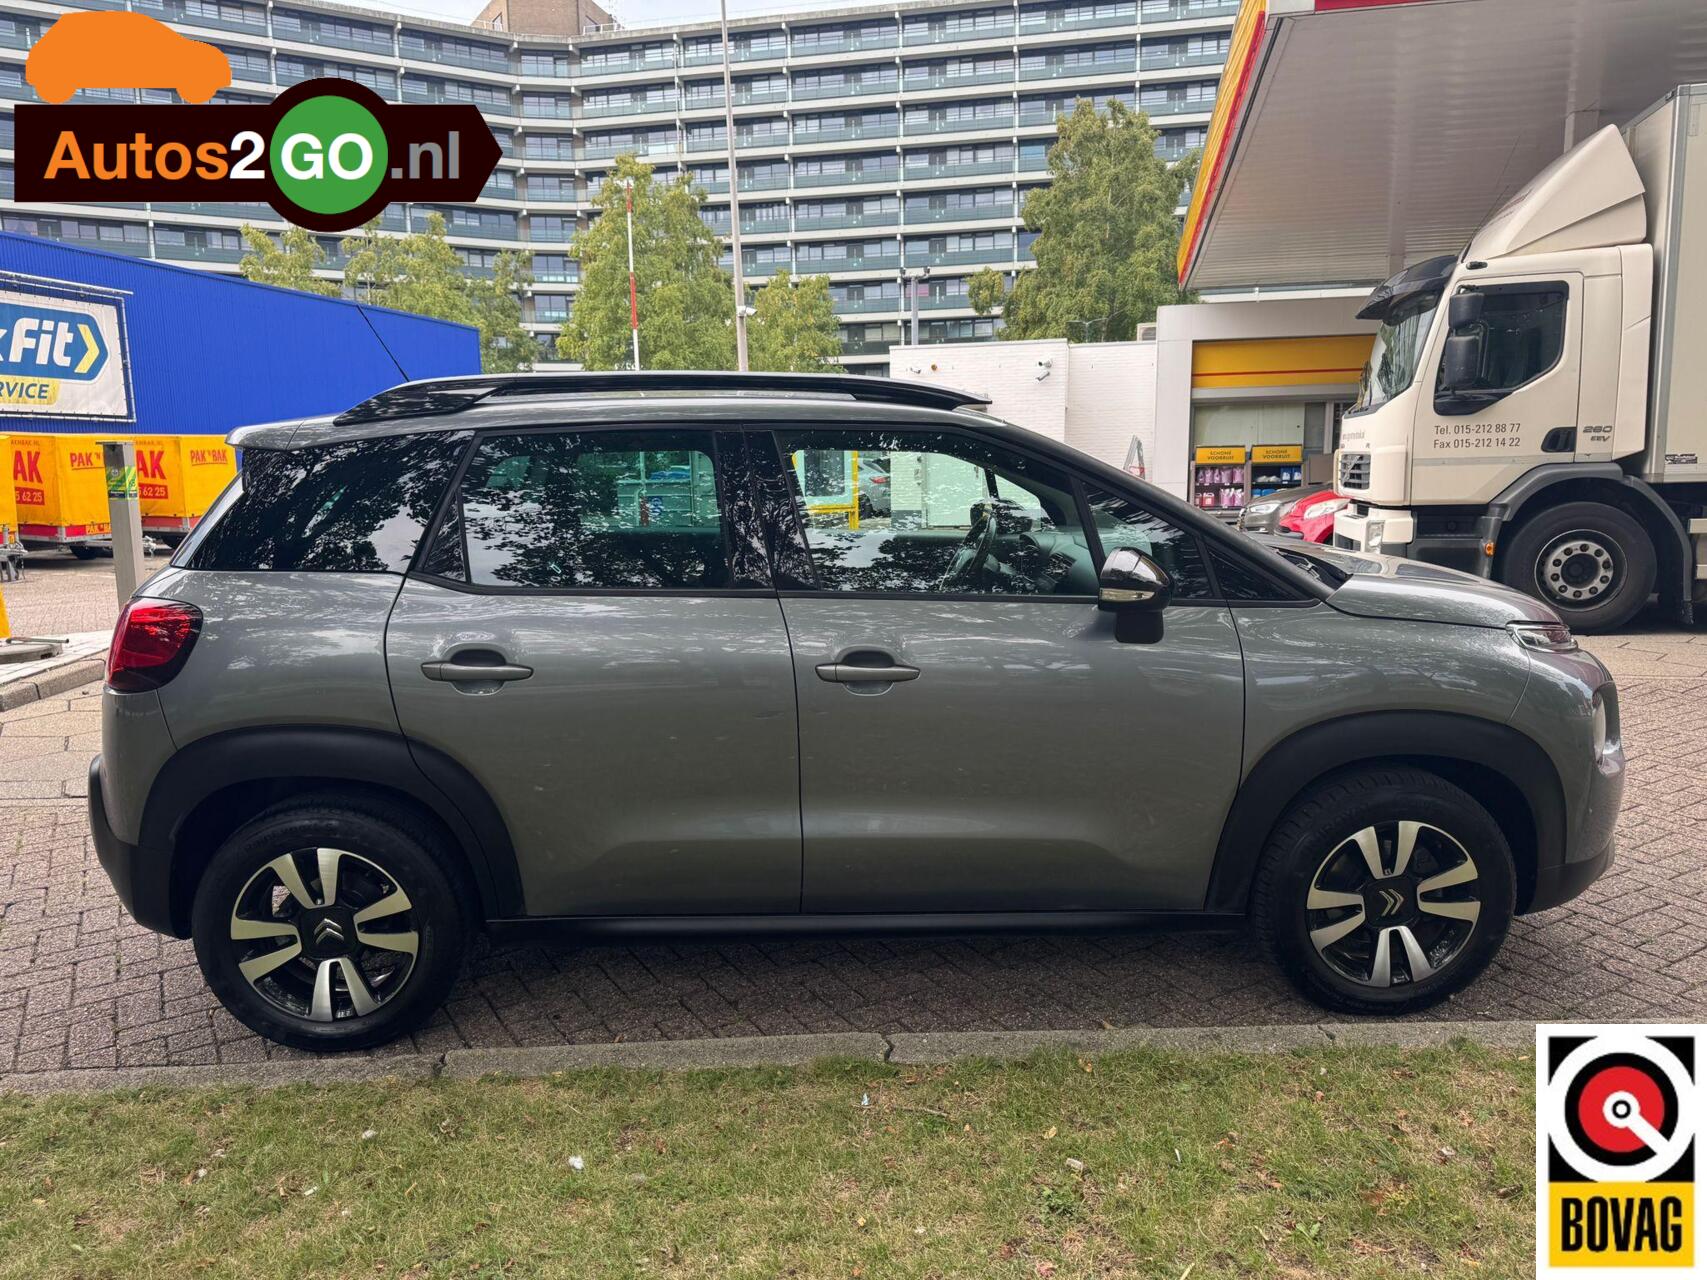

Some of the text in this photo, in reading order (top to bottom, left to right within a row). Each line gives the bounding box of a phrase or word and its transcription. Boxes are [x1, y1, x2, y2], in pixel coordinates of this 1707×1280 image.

[1434, 423, 1521, 435] Tel. 015-212 88 77
[1434, 437, 1520, 448] Fax 015-212 14 22
[70, 452, 93, 468] PAK
[190, 450, 206, 463] PAK
[212, 449, 228, 462] BAK
[143, 488, 154, 497] 62
[155, 489, 167, 497] 25
